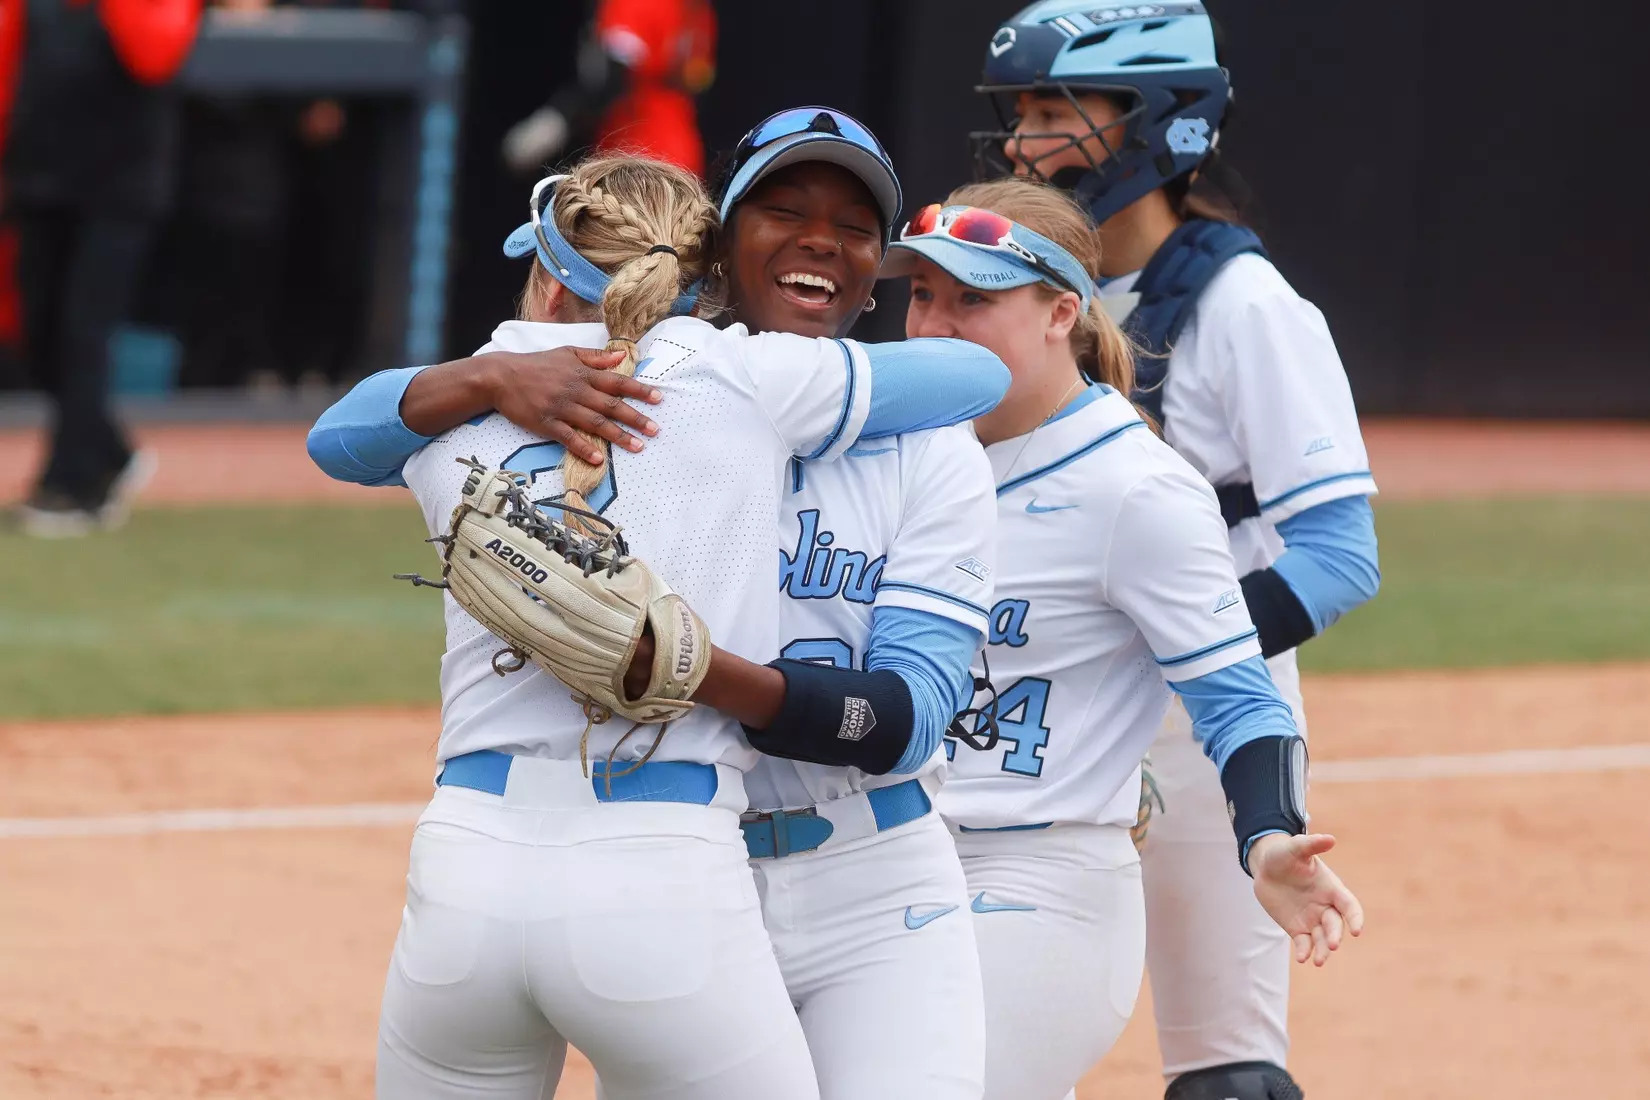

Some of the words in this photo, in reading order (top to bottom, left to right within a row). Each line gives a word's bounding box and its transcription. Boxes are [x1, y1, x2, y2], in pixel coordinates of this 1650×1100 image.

[969, 270, 1018, 283] SOFTBALL
[485, 538, 548, 584] A2000
[956, 558, 988, 581] ACC
[1213, 588, 1239, 612] ACC
[676, 610, 694, 674] Wilson
[840, 718, 849, 737] OWN
[845, 699, 860, 738] ZONE
[853, 700, 867, 739] SPORTS
